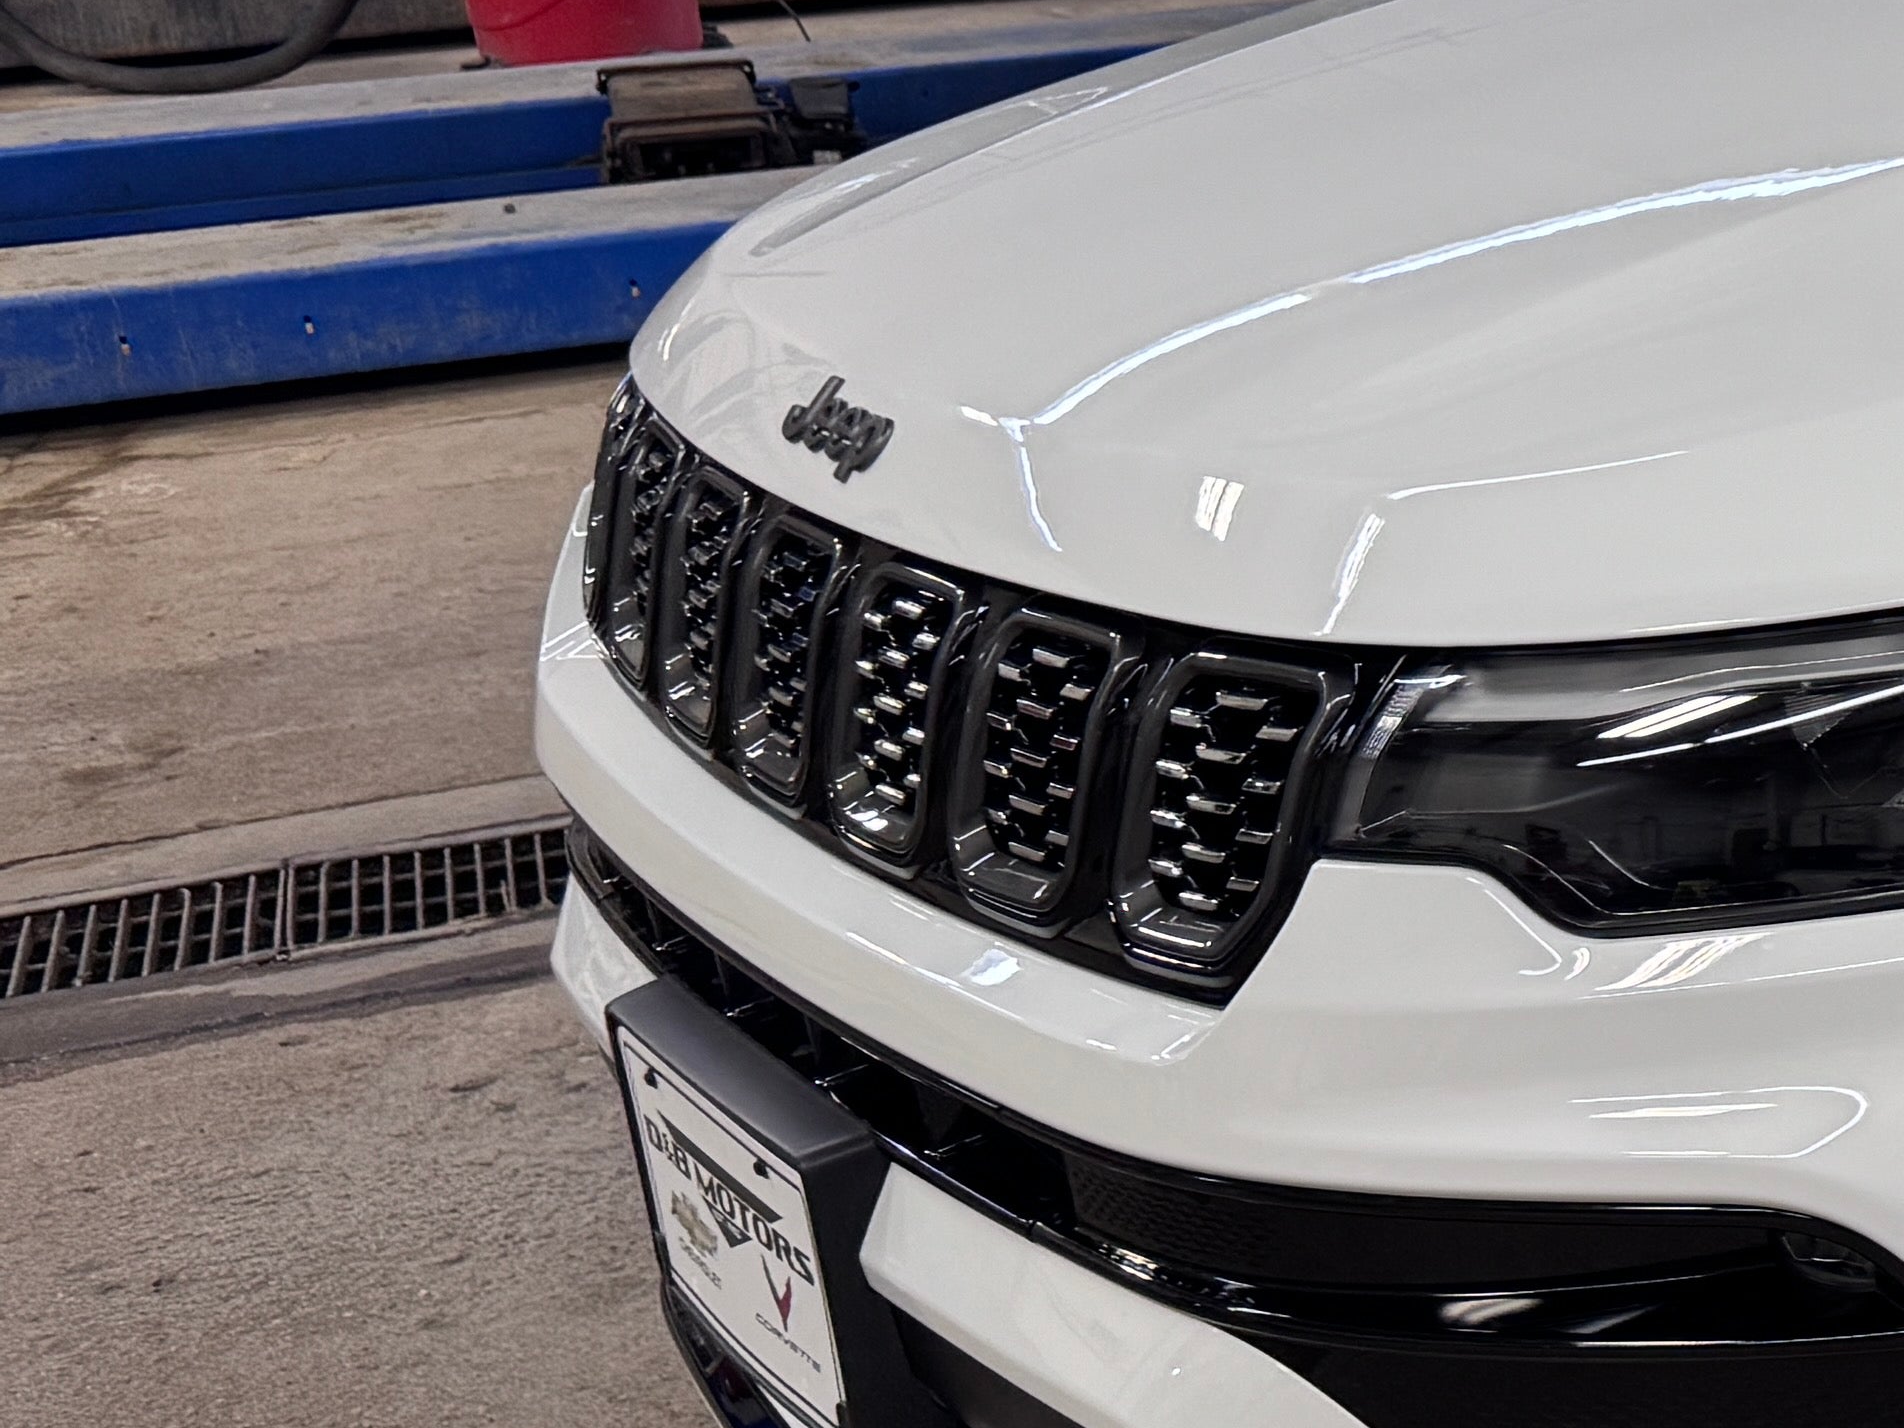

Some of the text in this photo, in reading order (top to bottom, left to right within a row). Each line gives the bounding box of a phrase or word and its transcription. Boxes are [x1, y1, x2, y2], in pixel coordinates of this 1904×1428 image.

[781, 375, 894, 484] Jeep
[643, 1113, 692, 1181] D&B
[693, 1161, 815, 1287] MOTORS
[755, 1312, 821, 1373] CORVETTE
